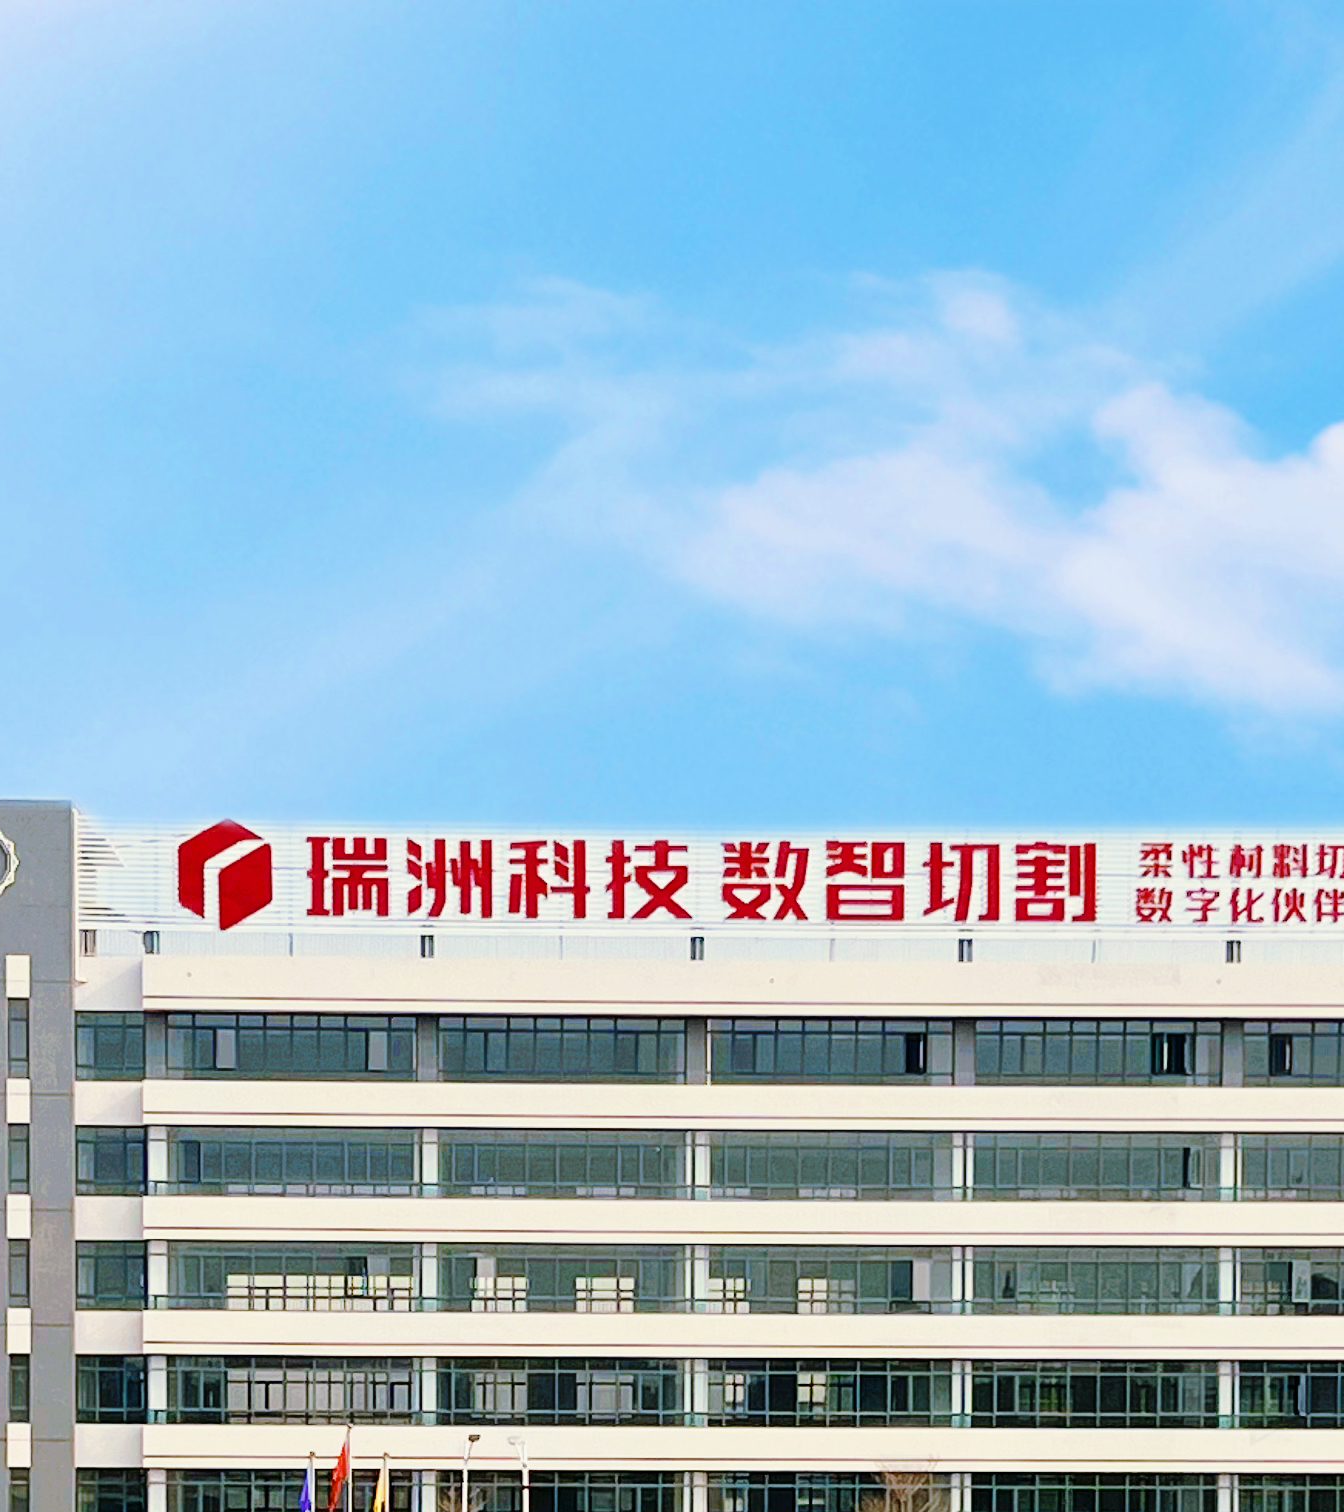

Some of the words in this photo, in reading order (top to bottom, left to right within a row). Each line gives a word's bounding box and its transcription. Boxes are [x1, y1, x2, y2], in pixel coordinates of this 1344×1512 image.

[306, 836, 693, 920] 瑞洲科技
[720, 840, 1098, 922] 数智切割
